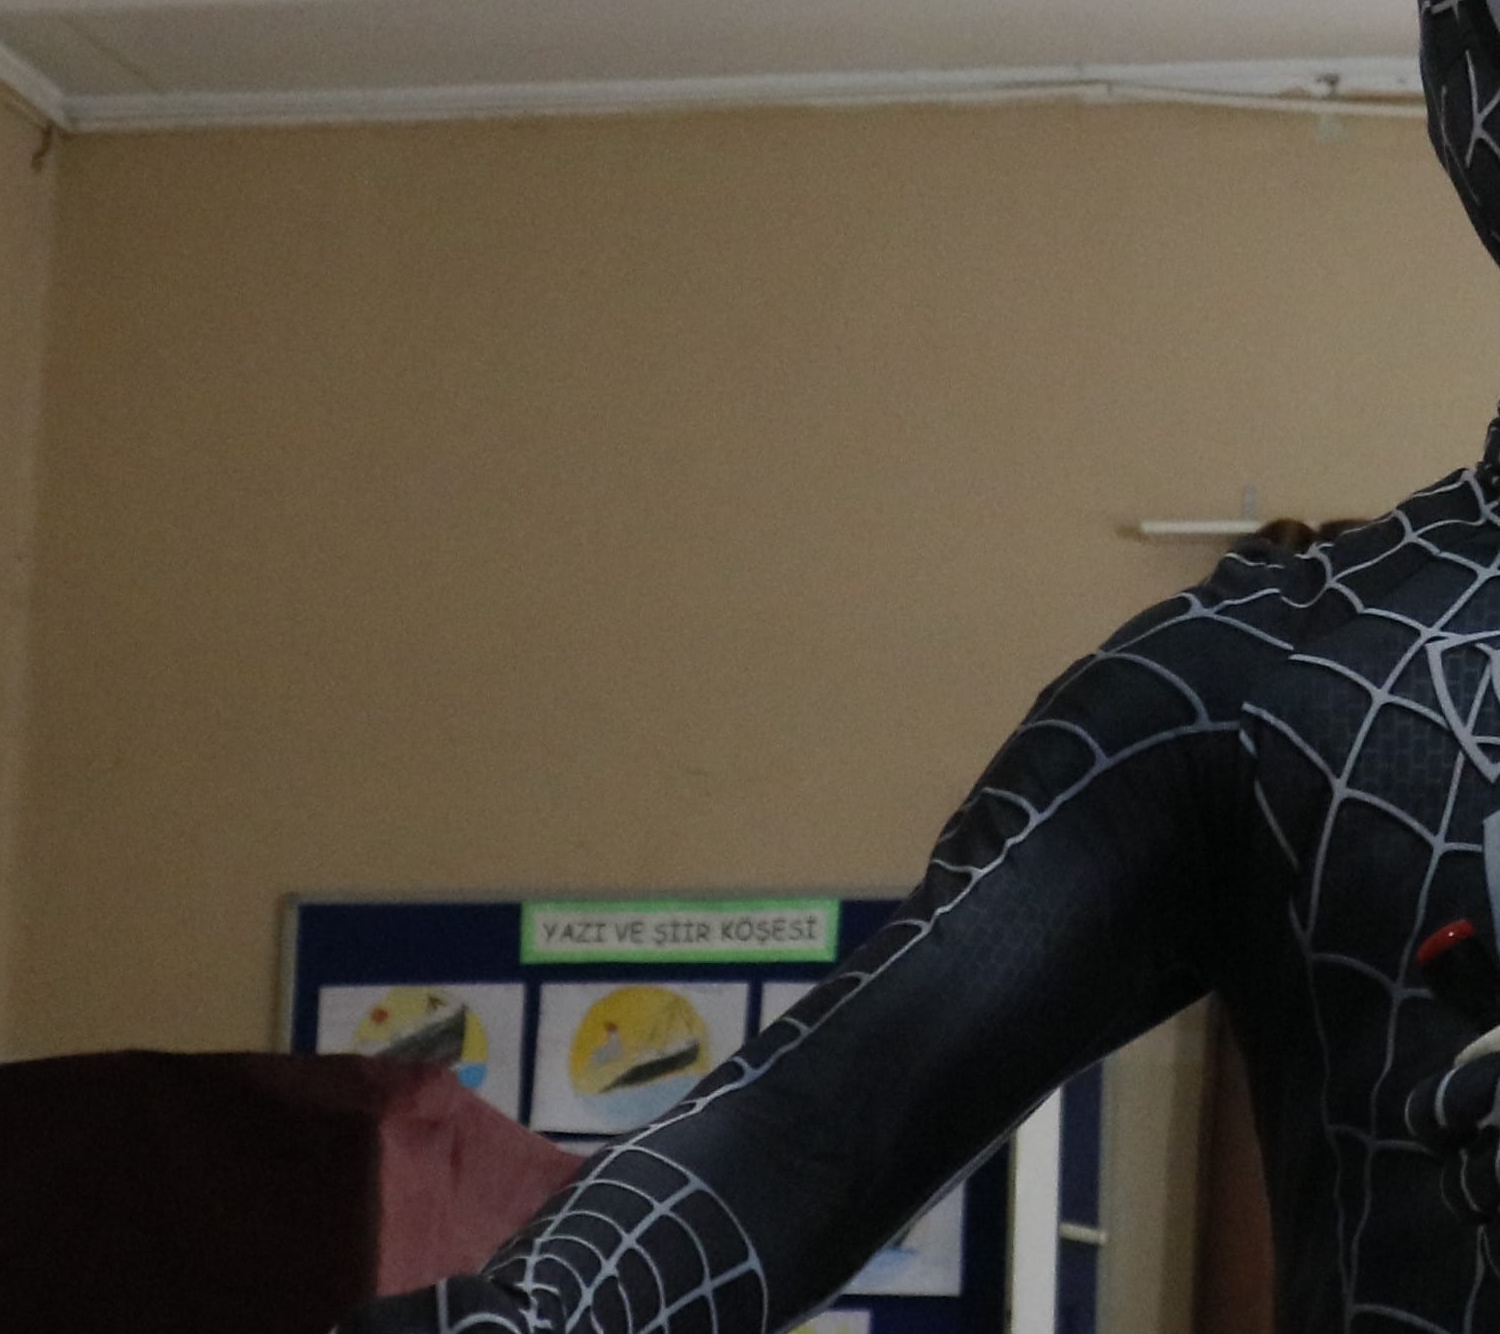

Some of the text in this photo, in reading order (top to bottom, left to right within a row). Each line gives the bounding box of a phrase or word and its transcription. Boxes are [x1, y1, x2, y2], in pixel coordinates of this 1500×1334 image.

[542, 916, 818, 947] YAZI VE ŞİİR KÖŞESİ
